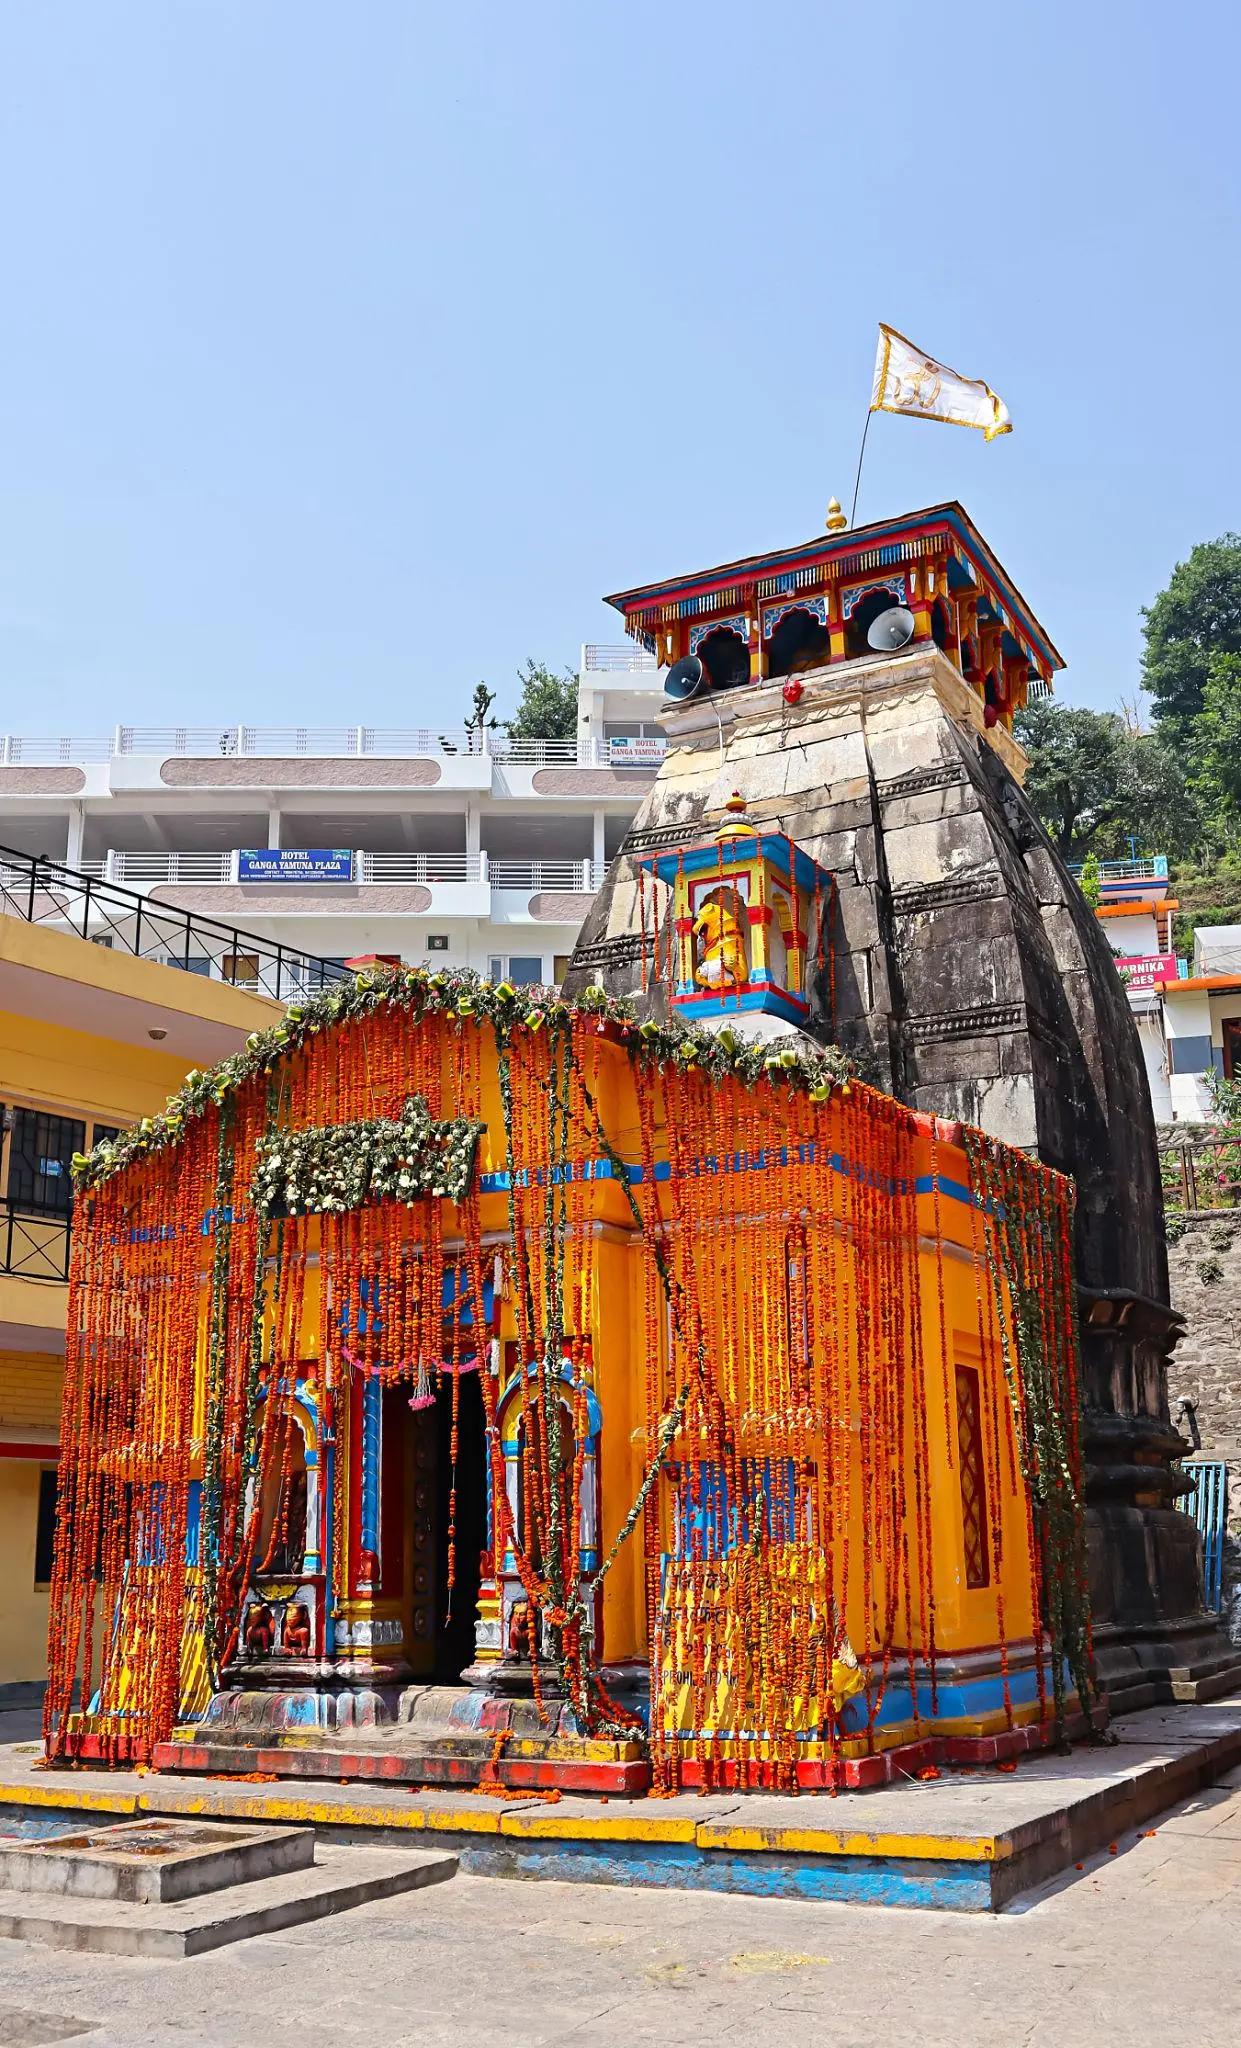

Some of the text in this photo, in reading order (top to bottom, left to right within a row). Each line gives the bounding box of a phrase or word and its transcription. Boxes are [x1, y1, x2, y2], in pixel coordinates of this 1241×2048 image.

[249, 861, 341, 869] GANGA YAMUNA PLAZA
